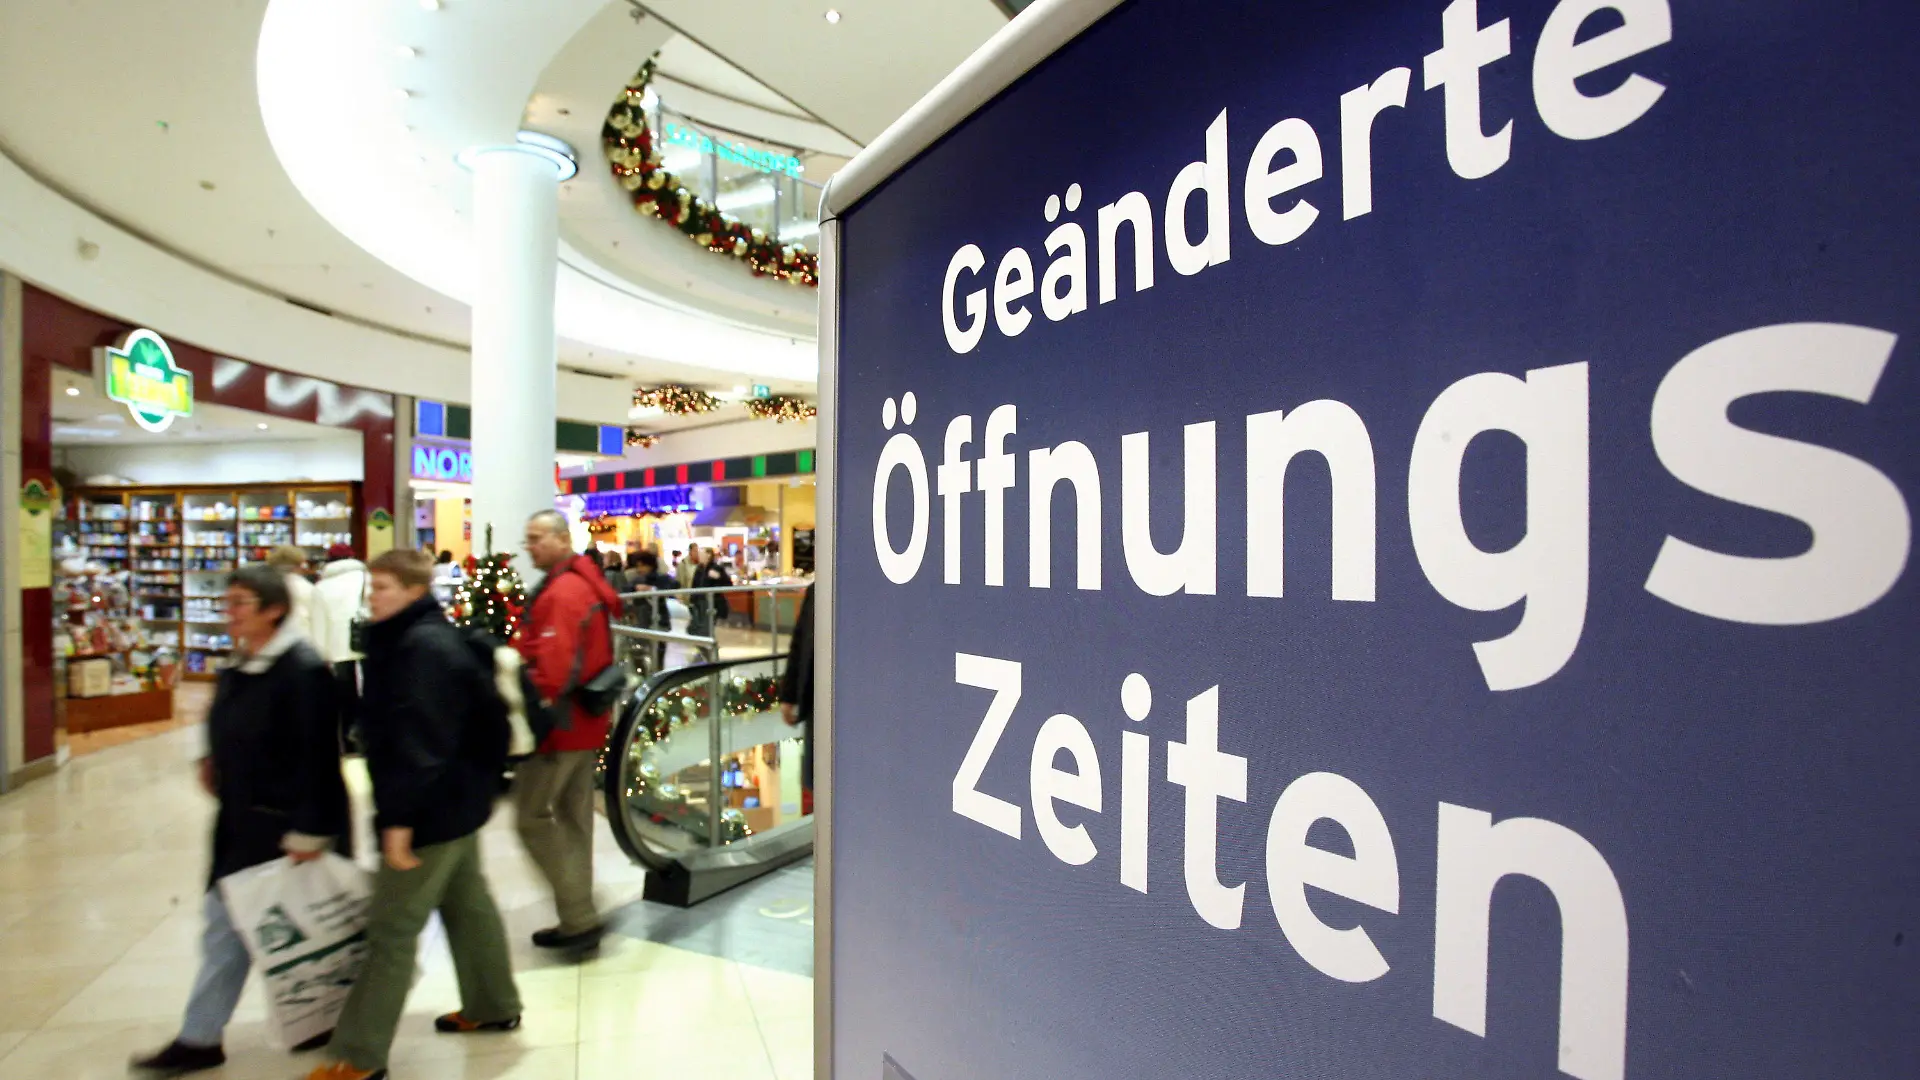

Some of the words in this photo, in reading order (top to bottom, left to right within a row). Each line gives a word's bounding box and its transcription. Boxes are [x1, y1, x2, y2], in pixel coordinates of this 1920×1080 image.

[942, 0, 1672, 354] Geänderte
[872, 323, 1910, 691] Öffnungs
[952, 652, 1630, 1080] Zeiten
